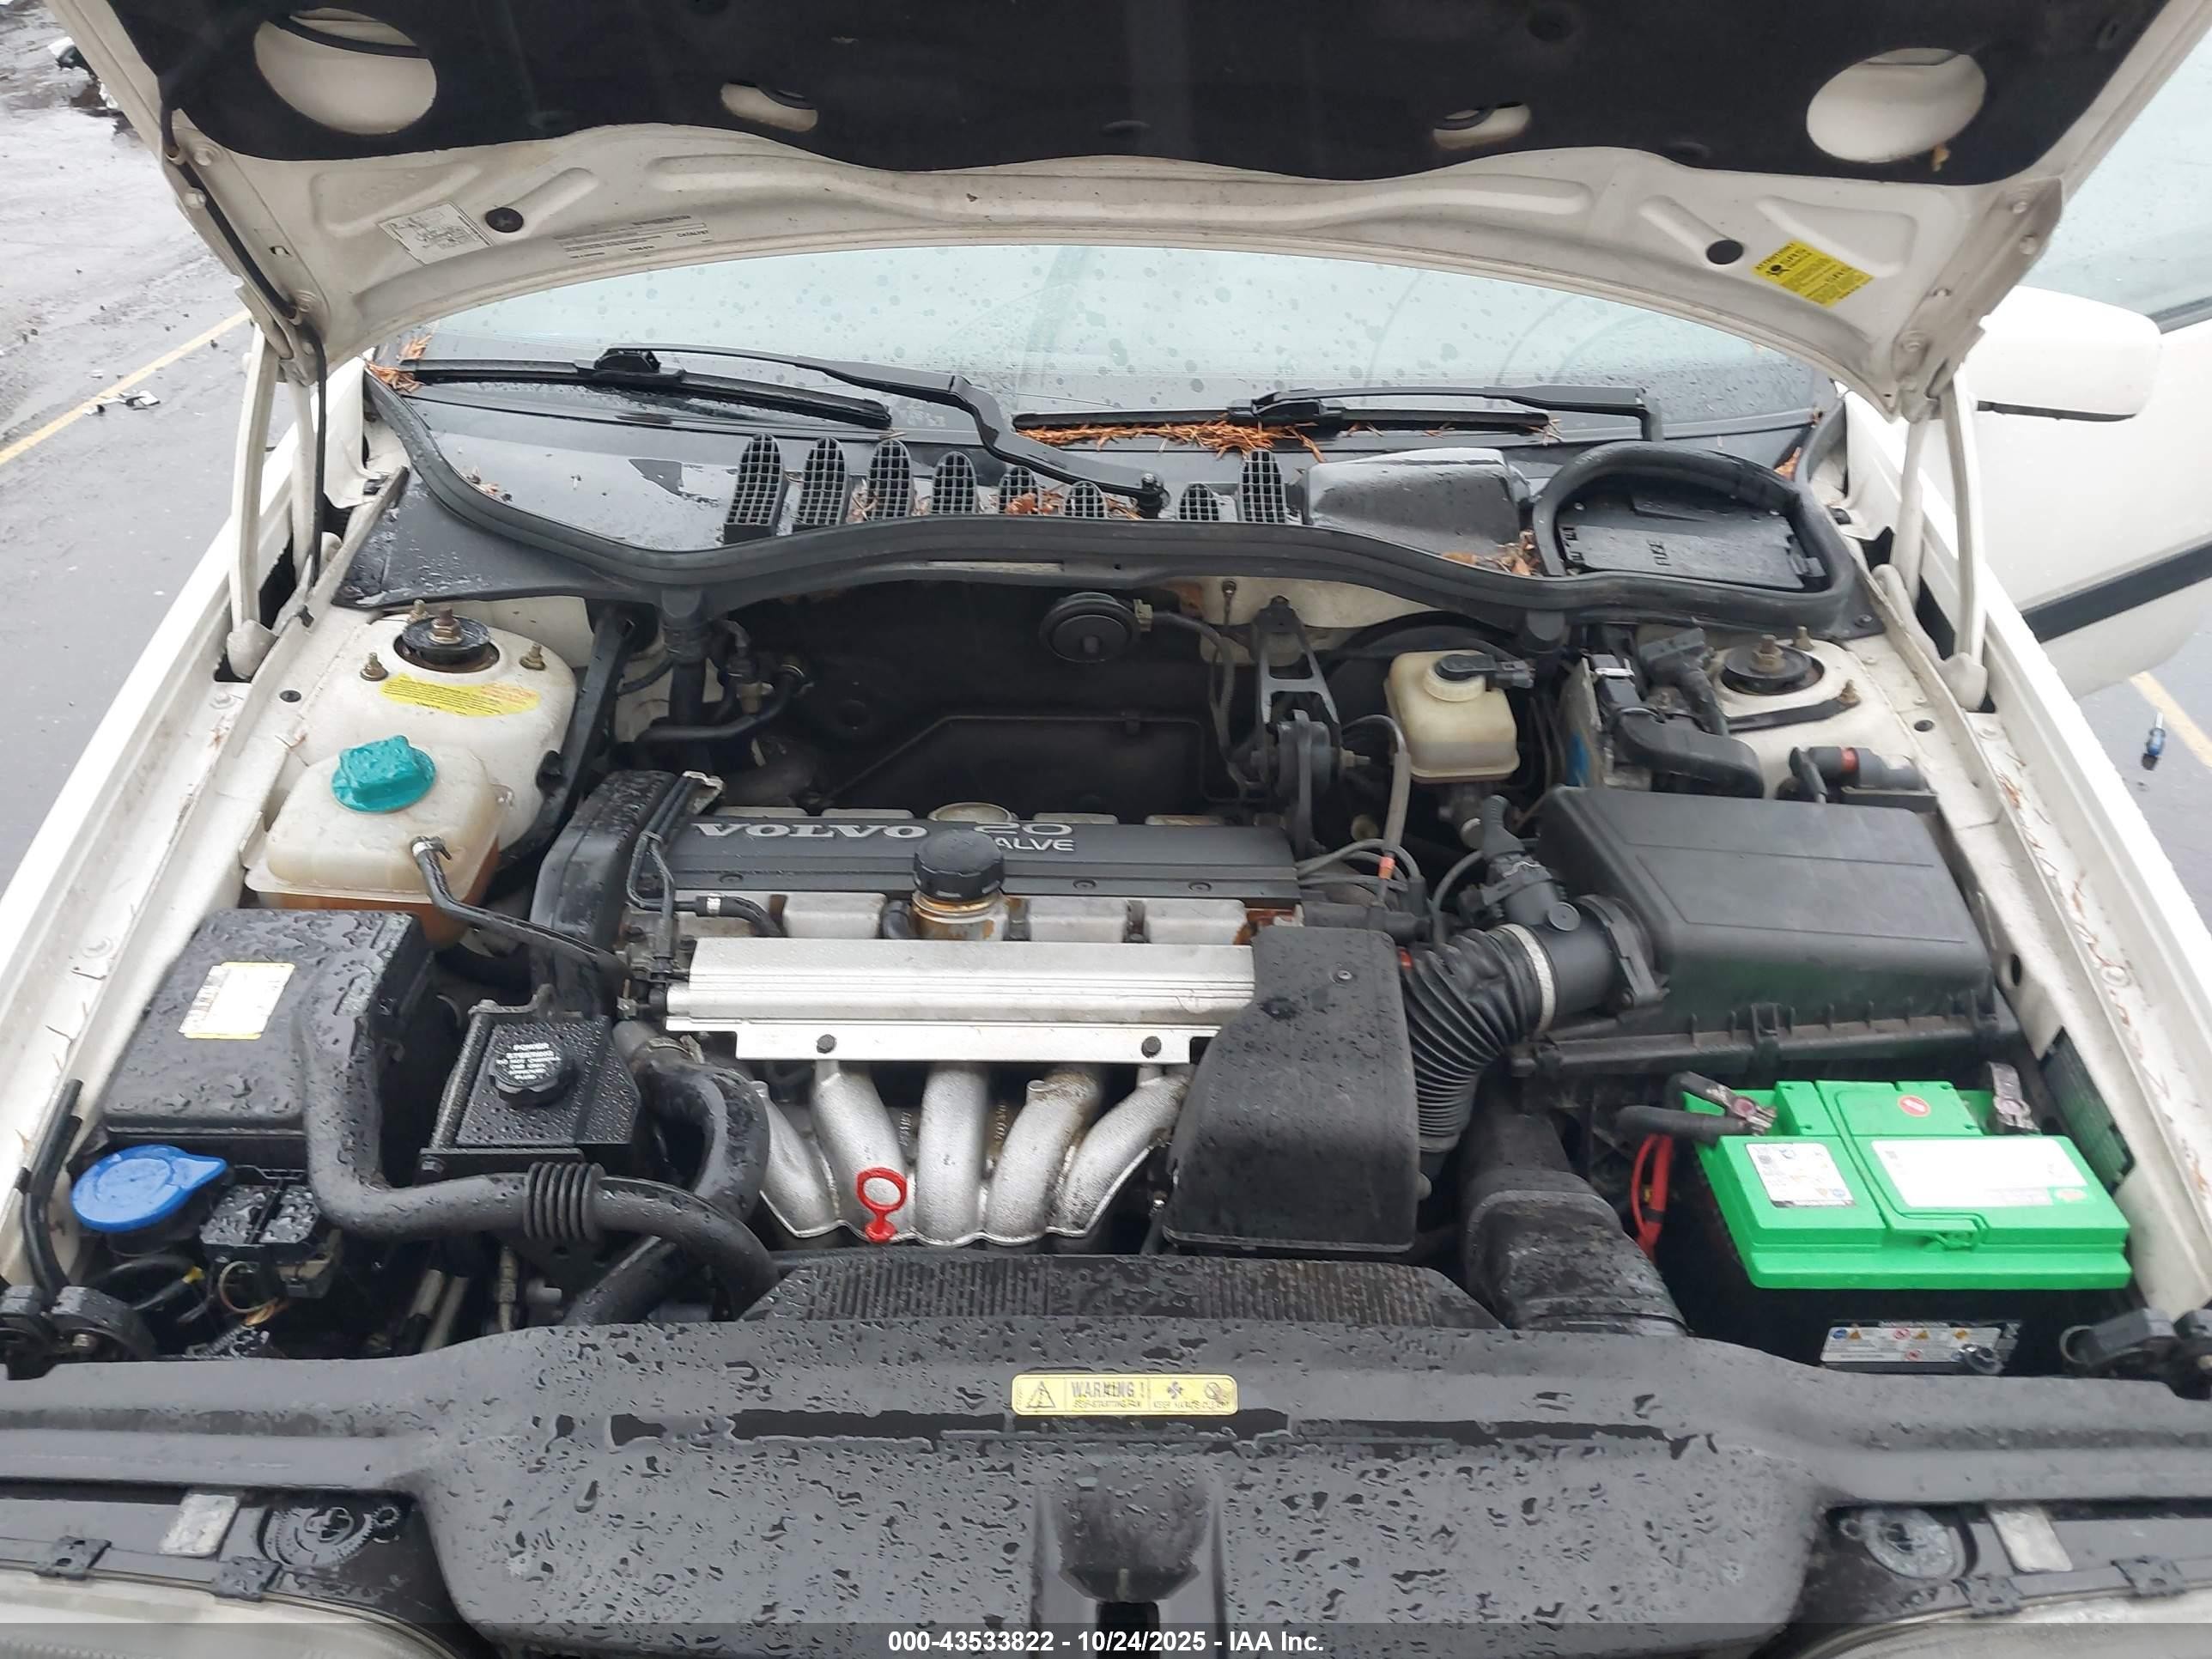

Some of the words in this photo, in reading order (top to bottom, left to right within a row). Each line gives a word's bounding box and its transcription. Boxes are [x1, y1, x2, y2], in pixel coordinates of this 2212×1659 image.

[692, 823, 928, 838] VOLVO
[973, 822, 1073, 836] 20
[993, 837, 1075, 852] ALVE
[1071, 1381, 1134, 1398] WARNING
